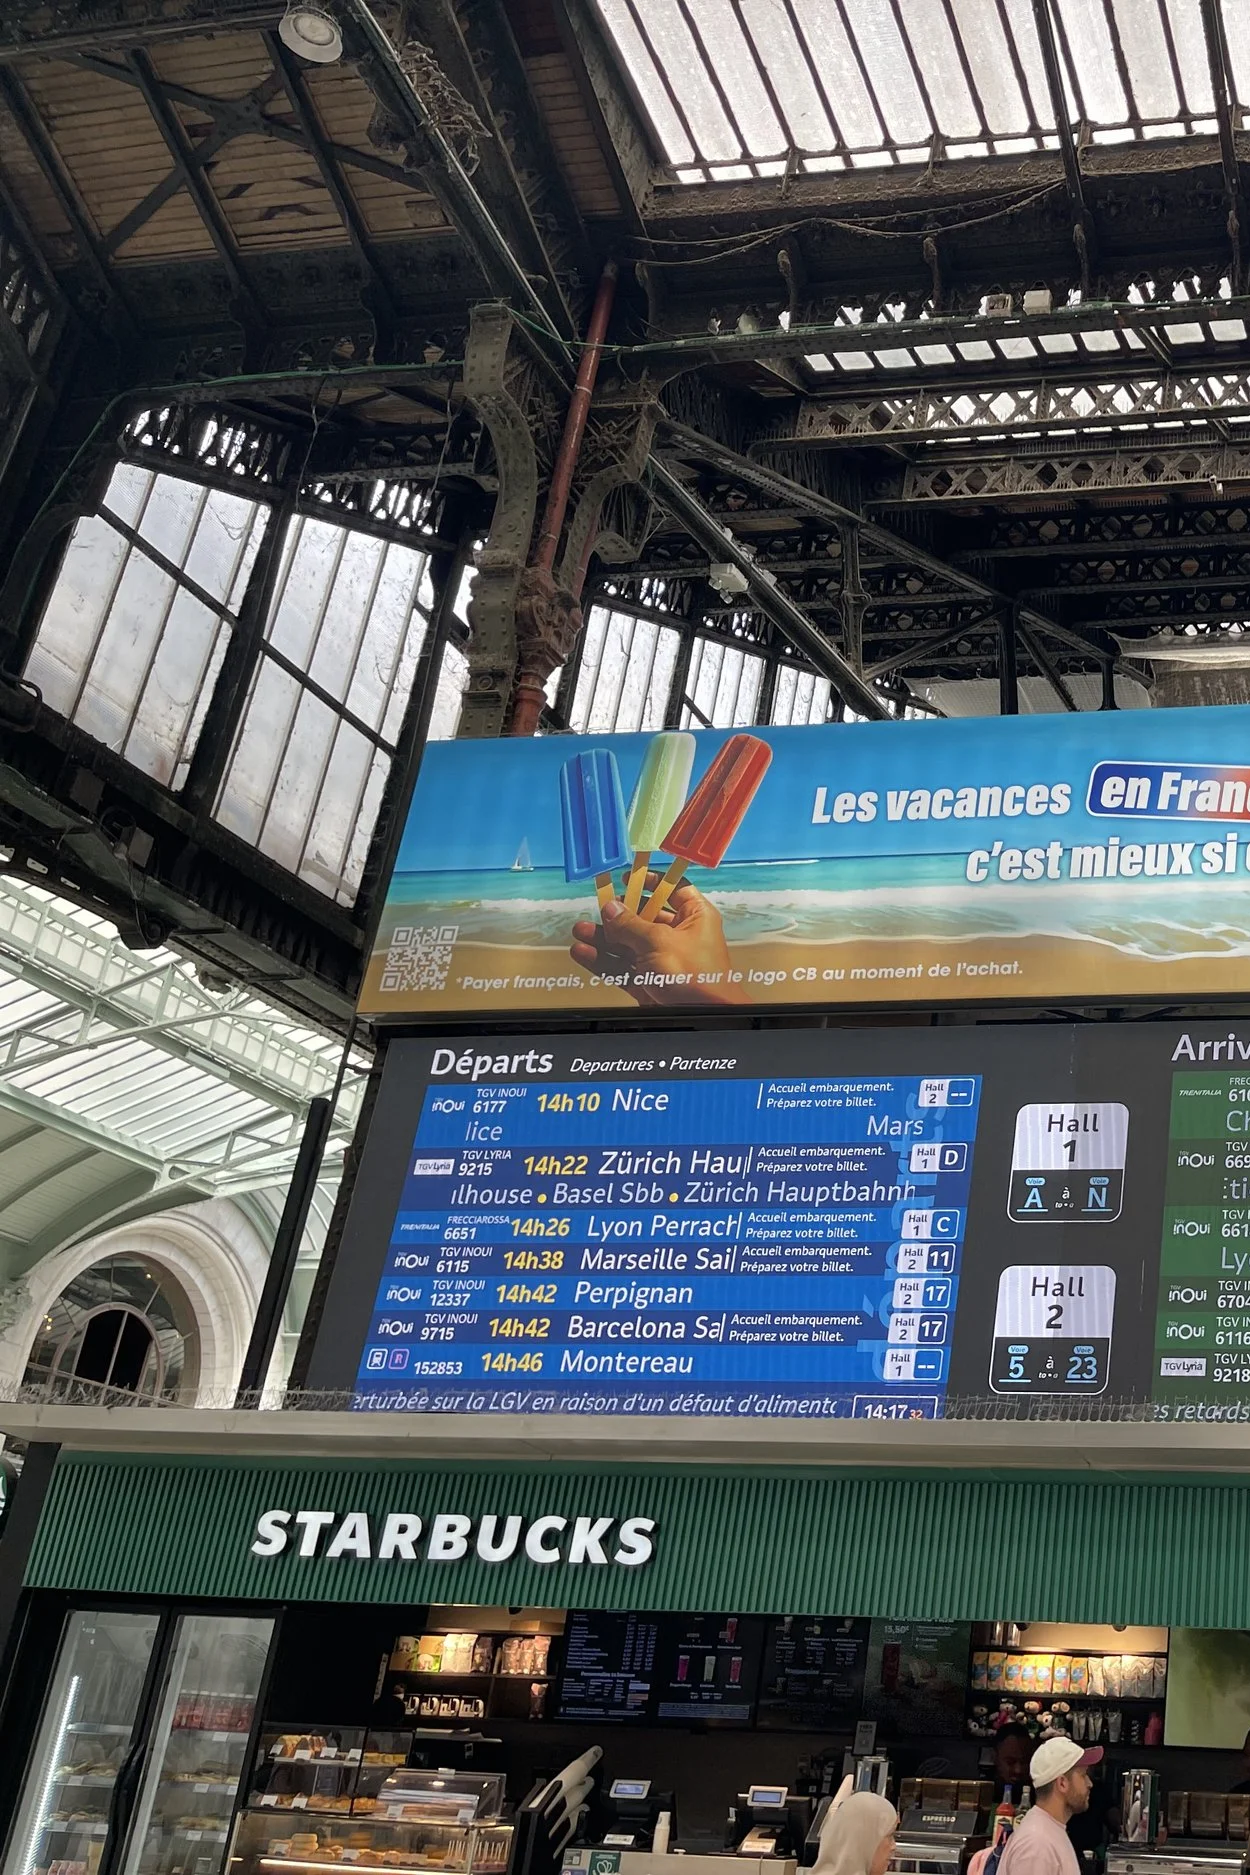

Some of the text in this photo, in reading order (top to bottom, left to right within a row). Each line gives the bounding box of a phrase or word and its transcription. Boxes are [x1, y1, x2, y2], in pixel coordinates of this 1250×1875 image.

[812, 787, 876, 824] Les
[887, 783, 1070, 821] vacances
[1101, 775, 1151, 809] en
[1070, 836, 1195, 877] mieux
[1202, 832, 1236, 873] si
[514, 974, 584, 991] français,
[634, 972, 692, 987] cliquer
[697, 972, 724, 983] sur
[728, 970, 742, 982] le
[748, 968, 786, 985] logo
[792, 968, 816, 981] CB
[822, 969, 844, 980] au
[850, 964, 922, 979] moment
[928, 964, 950, 977] de
[431, 1049, 737, 1081] Départs Departures Partenze
[768, 1082, 894, 1094] Accueil embarquement.
[925, 1084, 944, 1092] Hall
[473, 1089, 669, 1114] 6177 14h10 Nice
[766, 1097, 876, 1109] Préparez votre billet.
[929, 1095, 936, 1104] 2
[867, 1115, 923, 1136] Mars
[1047, 1114, 1099, 1132] Hall
[462, 1150, 512, 1160] TGV LYRIA
[917, 1148, 935, 1156] Hall
[945, 1150, 958, 1165] D
[1063, 1140, 1076, 1162] 1
[458, 1163, 492, 1176] 9215
[524, 1156, 589, 1175] 14h22
[598, 1151, 681, 1175] Zürich
[921, 1159, 928, 1168] 1
[553, 1183, 613, 1204] Basel
[620, 1182, 664, 1203] Sbb
[684, 1179, 758, 1203] Zürich
[768, 1180, 915, 1207] Hauptbahnh
[1024, 1188, 1107, 1208] A à N
[444, 1228, 476, 1240] 6651
[511, 1218, 570, 1237] 14h26
[587, 1215, 642, 1241] Lyon
[908, 1215, 927, 1223] Hall
[937, 1217, 950, 1233] C
[913, 1226, 920, 1236] 1
[436, 1247, 730, 1273] 6115 14h38 Marseille Sai
[430, 1281, 693, 1309] 12337 14h42 Perpignan
[1031, 1276, 1084, 1296] Hall
[1046, 1304, 1062, 1328] 2
[420, 1315, 721, 1340] 9715 14h42 Barcelona Sa
[414, 1350, 693, 1375] 152853 14h46 Montereau
[1008, 1356, 1097, 1378] 5 à 23
[1213, 1369, 1250, 1383] 9218
[431, 1396, 463, 1410] sur
[465, 1392, 486, 1410] la
[489, 1392, 530, 1410] LGV
[531, 1397, 555, 1410] en
[559, 1394, 617, 1411] raison
[669, 1394, 734, 1413] défaut
[251, 1509, 656, 1566] STARBUCKS
